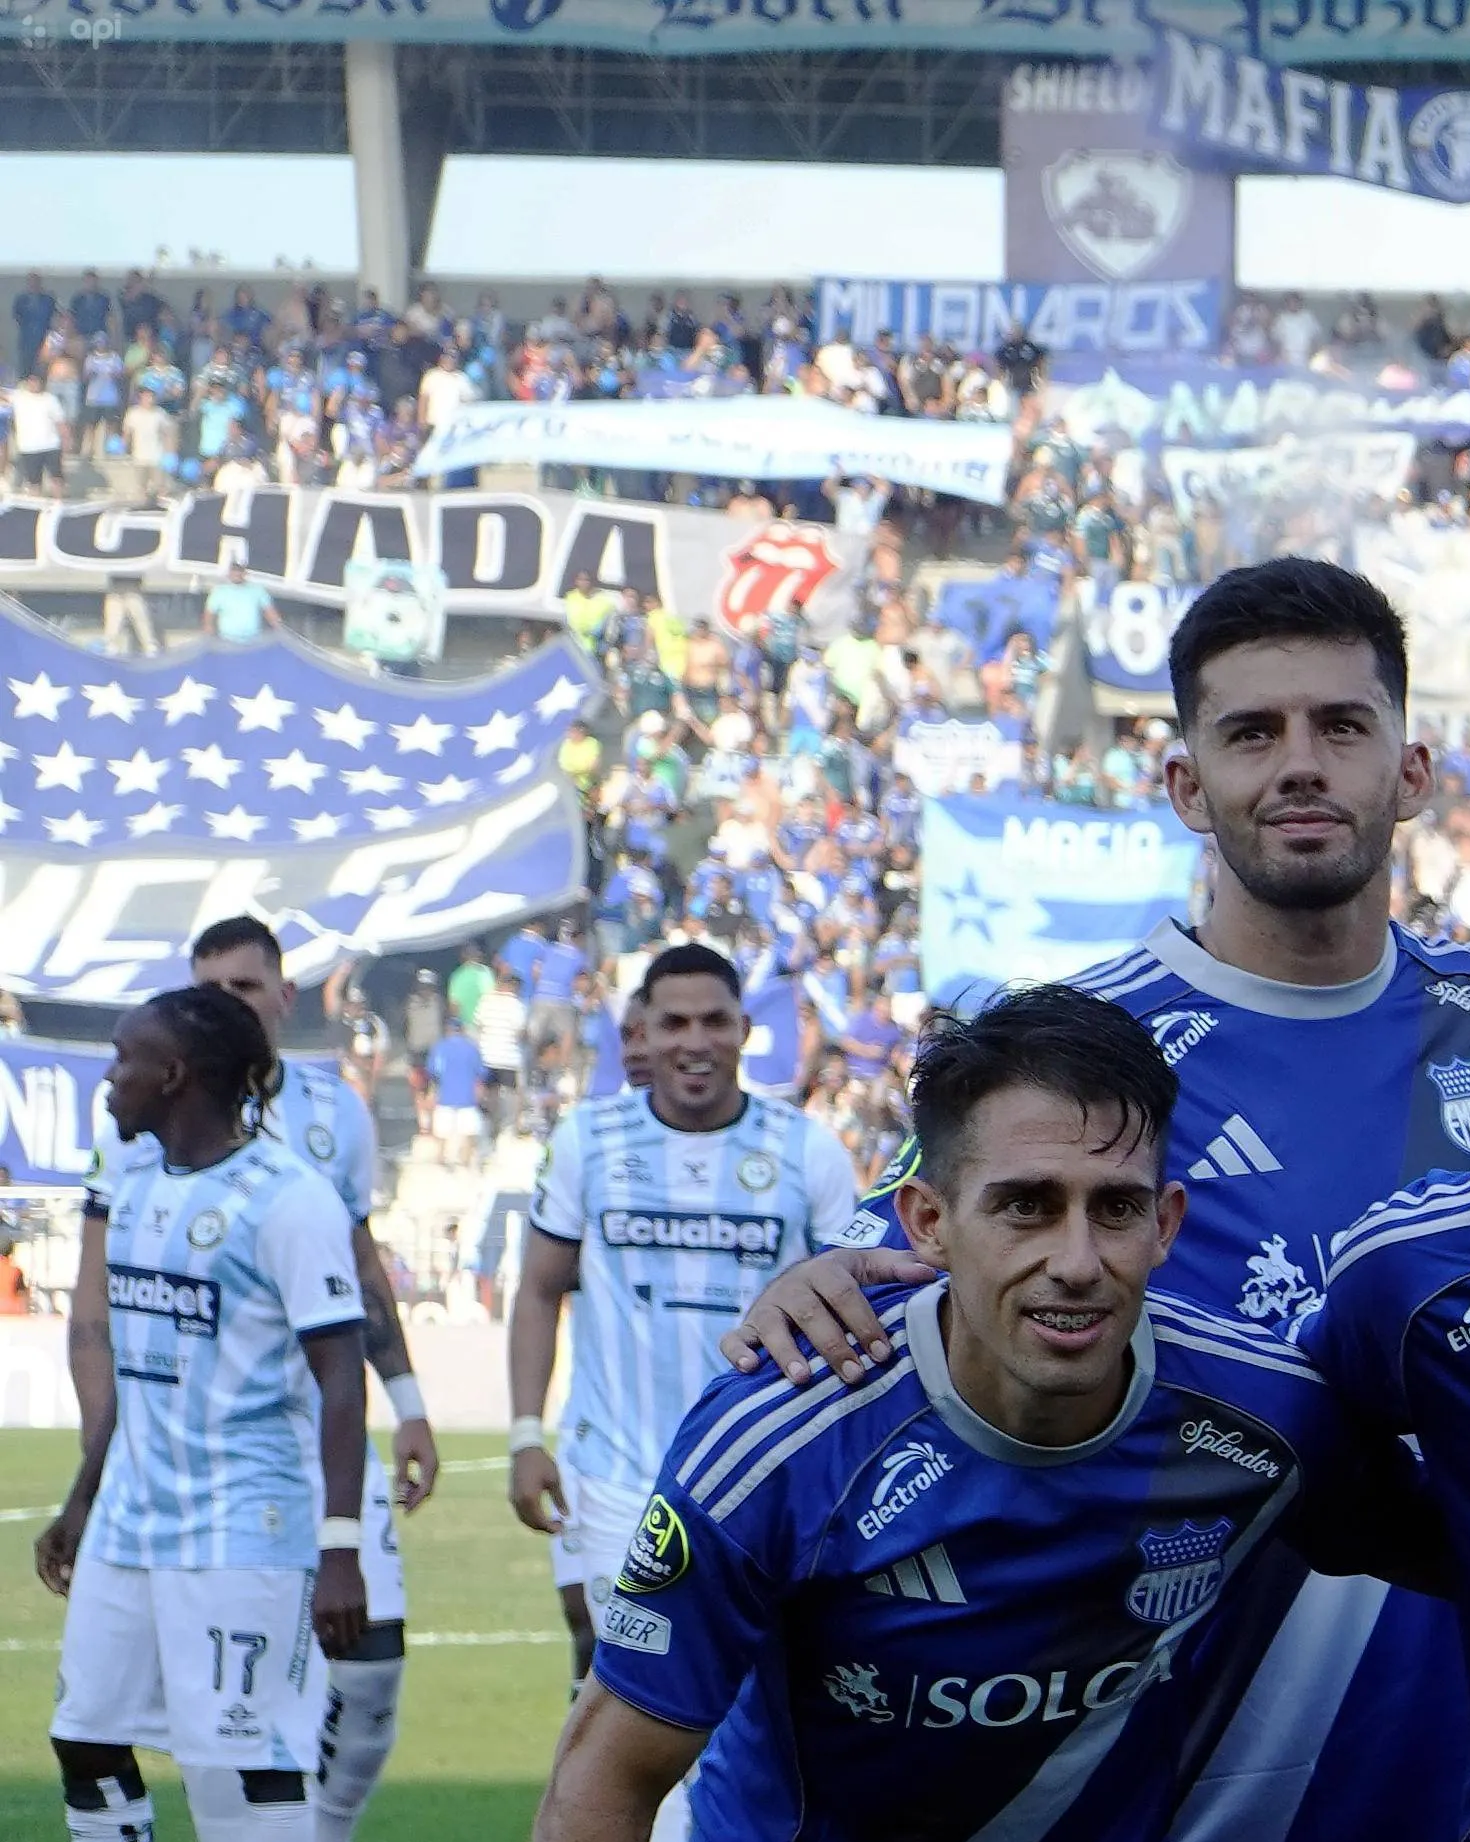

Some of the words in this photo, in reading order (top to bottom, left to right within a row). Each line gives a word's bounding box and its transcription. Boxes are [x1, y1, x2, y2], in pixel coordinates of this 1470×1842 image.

[1159, 28, 1413, 191] MAFIA
[602, 1210, 781, 1250] Ecuabet
[1180, 1419, 1281, 1479] Splendor
[857, 1451, 954, 1541] Electrolit
[1129, 1559, 1222, 1623] EMELEC
[207, 1626, 266, 1695] 17
[922, 1650, 1173, 1729] SOLCA
